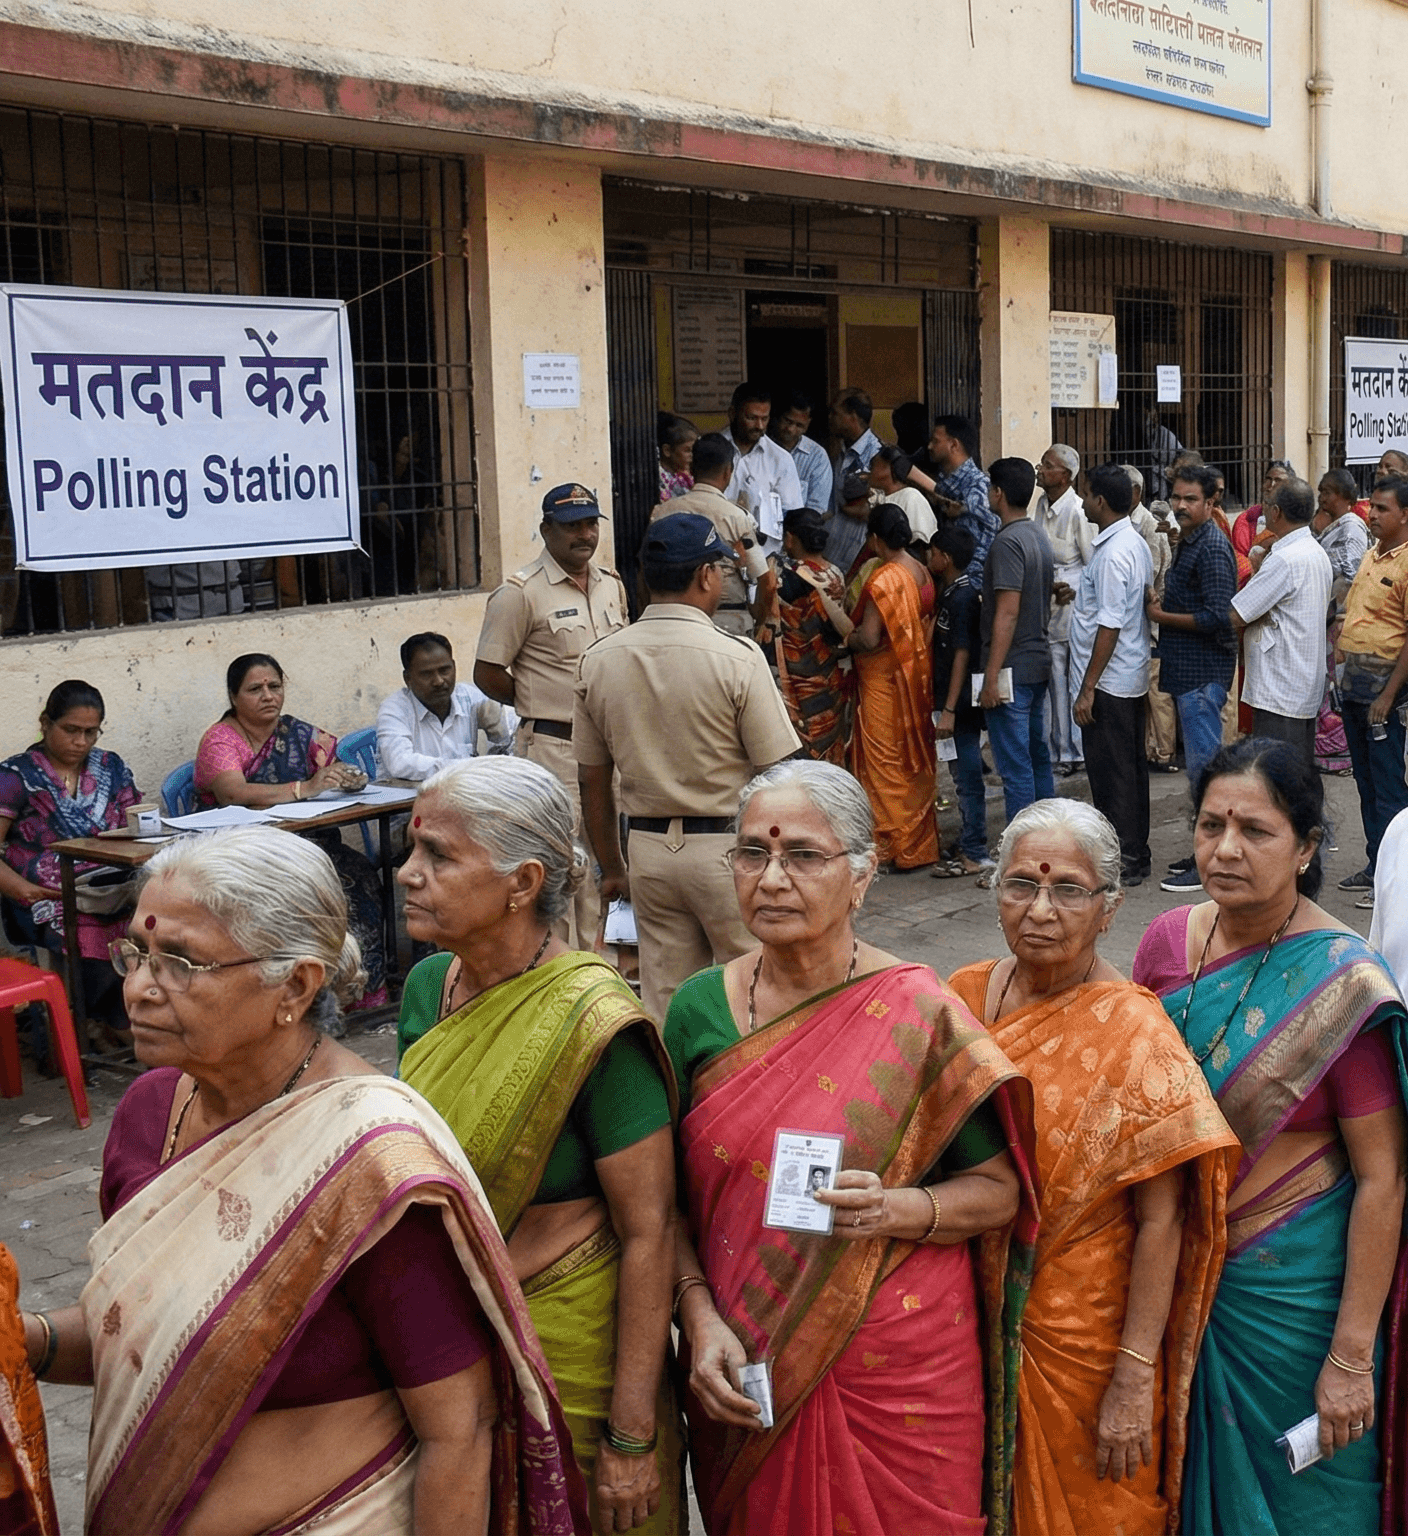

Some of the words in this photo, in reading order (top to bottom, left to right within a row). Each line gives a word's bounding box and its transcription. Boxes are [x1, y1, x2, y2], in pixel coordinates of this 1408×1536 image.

[31, 352, 227, 427] मतदान
[240, 328, 330, 425] केंद्र
[1349, 366, 1395, 399] मतदान
[1350, 412, 1387, 444] Polling
[33, 457, 188, 520] Polling
[203, 452, 341, 505] Station
